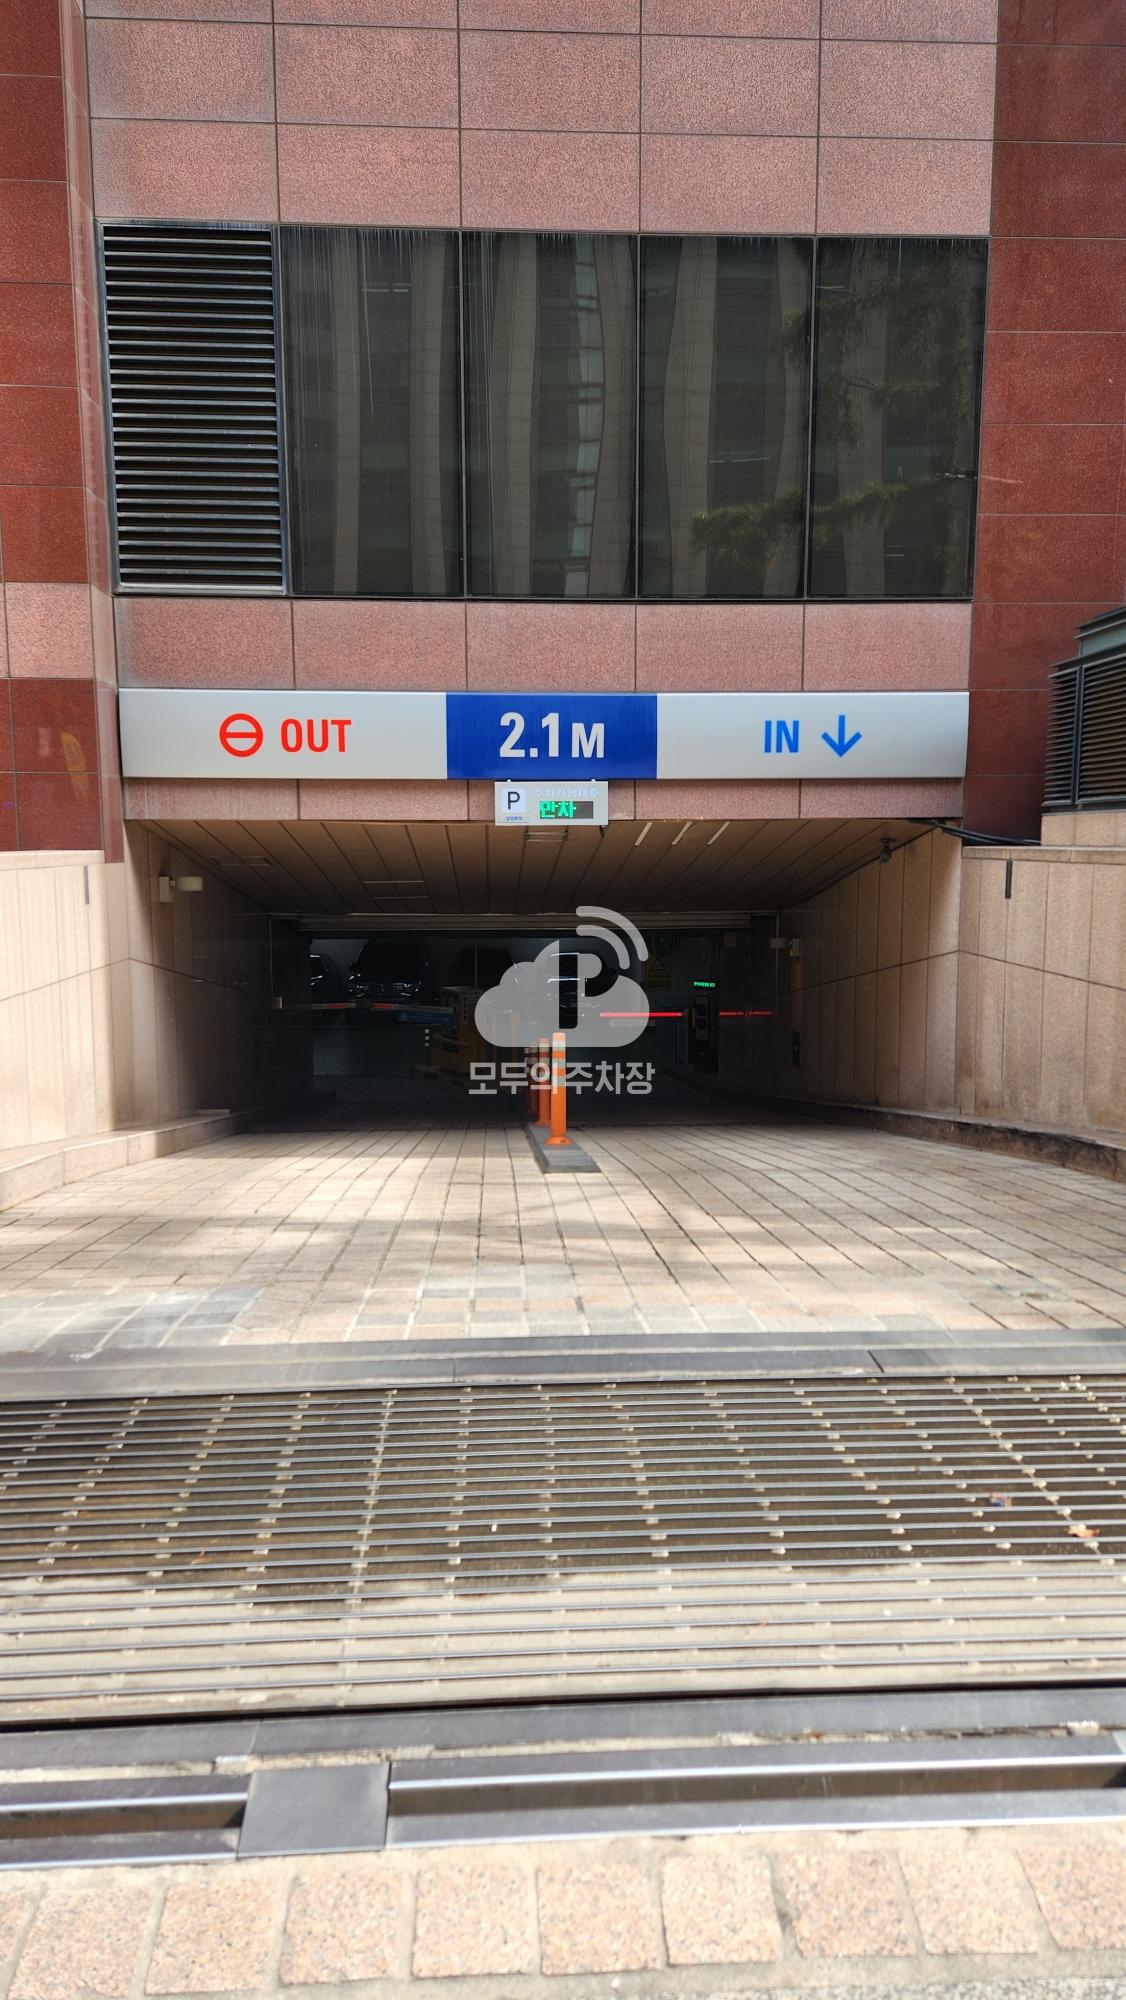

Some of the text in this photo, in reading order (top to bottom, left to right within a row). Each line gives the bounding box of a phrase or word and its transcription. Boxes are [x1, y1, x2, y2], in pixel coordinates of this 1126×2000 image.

[279, 717, 353, 753] OUT
[763, 719, 801, 754] IN
[507, 791, 521, 810] P
[539, 800, 577, 819] 만차
